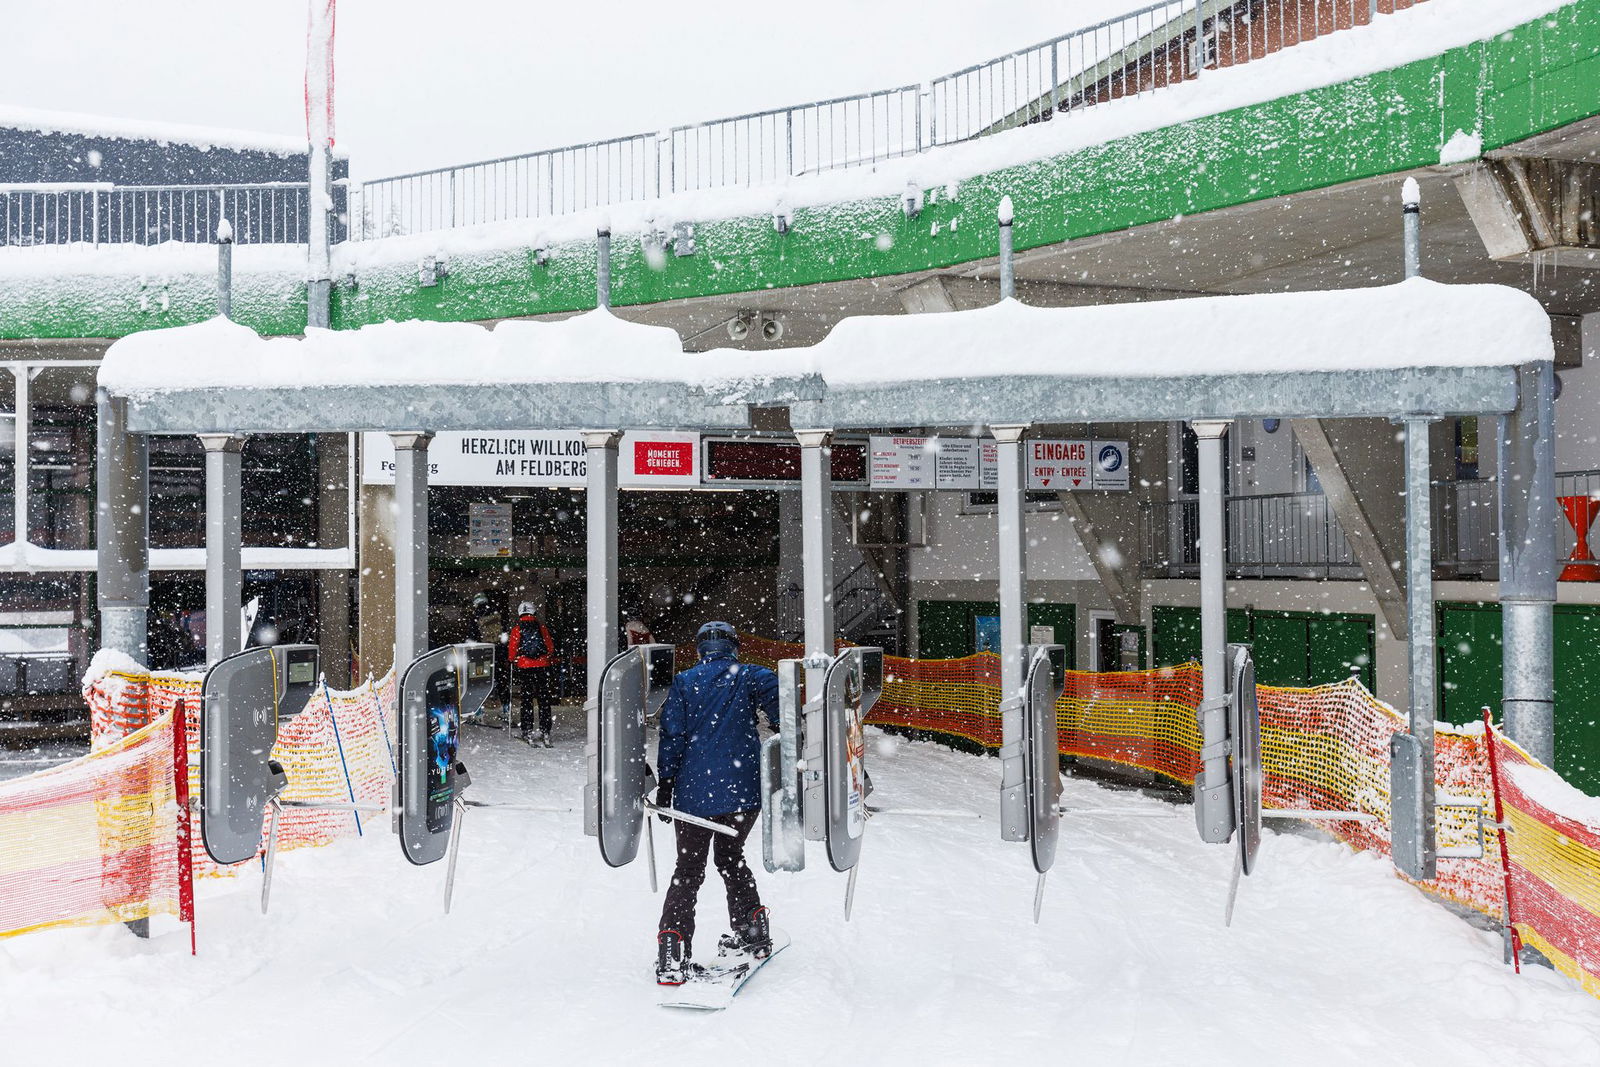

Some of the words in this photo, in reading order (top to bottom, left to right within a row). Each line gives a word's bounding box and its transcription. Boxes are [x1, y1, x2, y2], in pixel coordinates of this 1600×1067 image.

[461, 437, 526, 456] HERZLICH
[647, 449, 680, 459] MOMENTE
[1035, 443, 1085, 460] EINGANG
[495, 460, 515, 476] AM
[521, 460, 587, 477] FELDBERG
[1034, 467, 1055, 477] ENTRY
[1061, 466, 1086, 477] ENTRÉE
